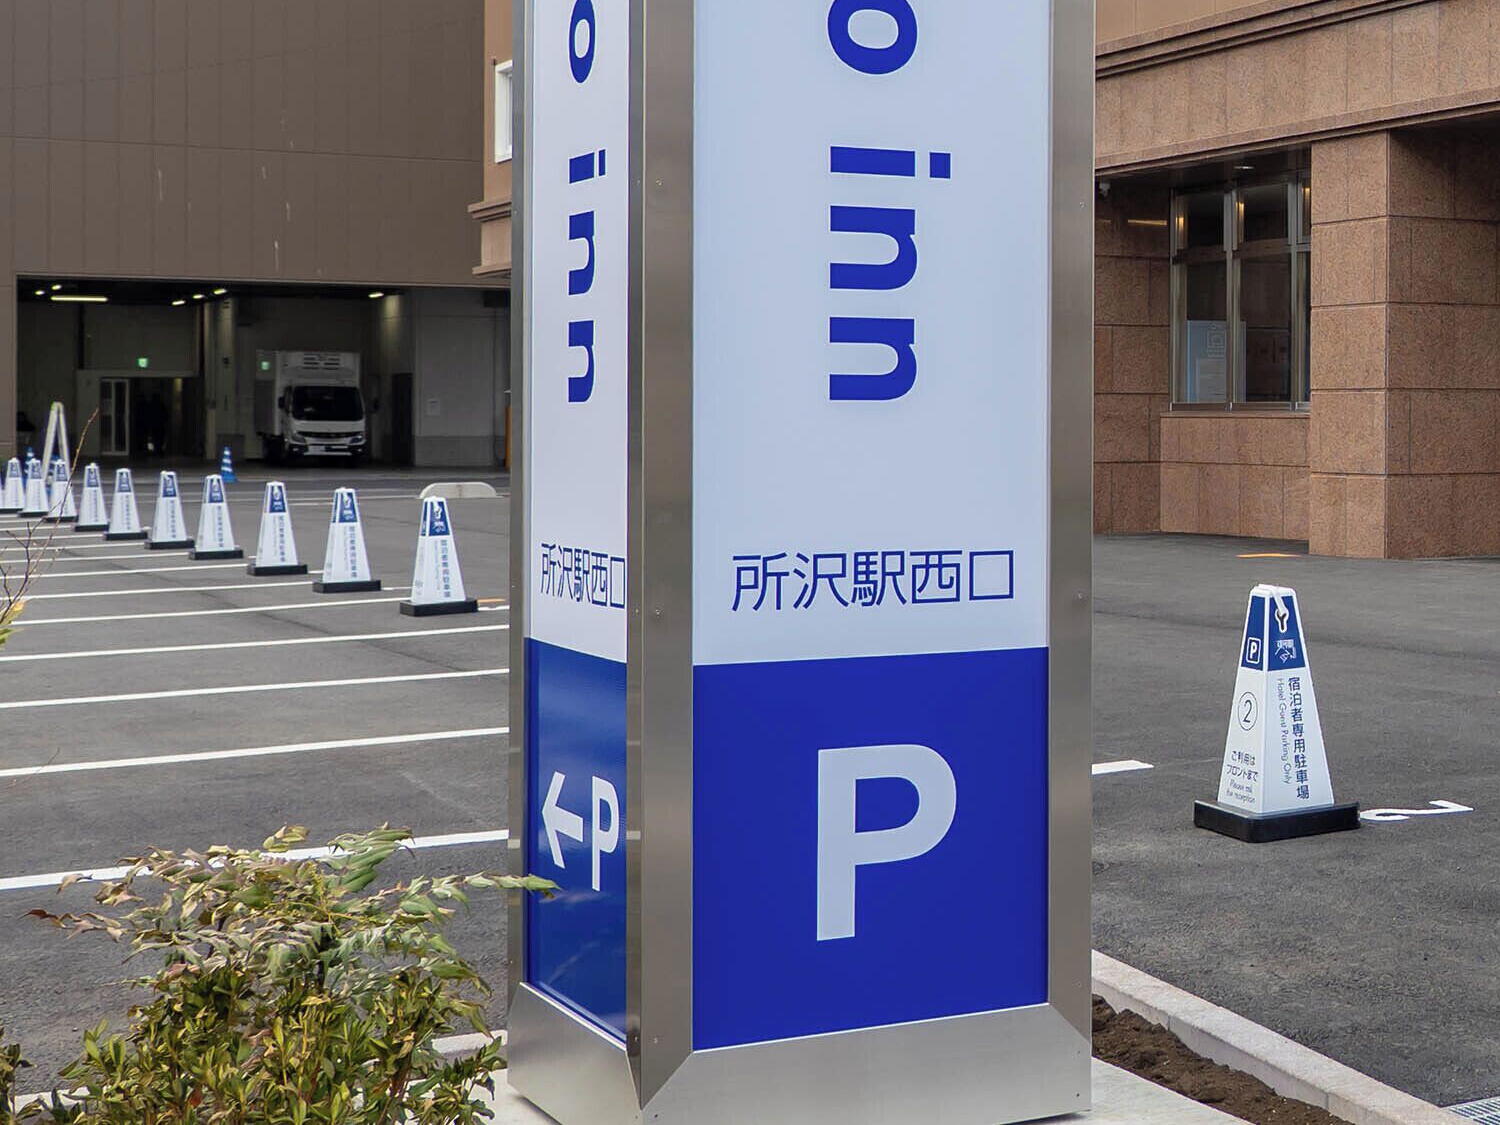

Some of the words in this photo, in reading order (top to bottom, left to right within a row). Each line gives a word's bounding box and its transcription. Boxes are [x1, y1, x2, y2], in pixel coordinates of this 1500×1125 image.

[568, 149, 606, 403] inn
[828, 146, 951, 401] inn
[540, 542, 626, 610] 所沢駅西口
[731, 549, 1015, 612] 所沢駅西口
[1249, 641, 1258, 659] P
[1288, 676, 1310, 800] 宿泊者専用駐車場
[591, 775, 621, 892] P
[816, 743, 958, 942] P
